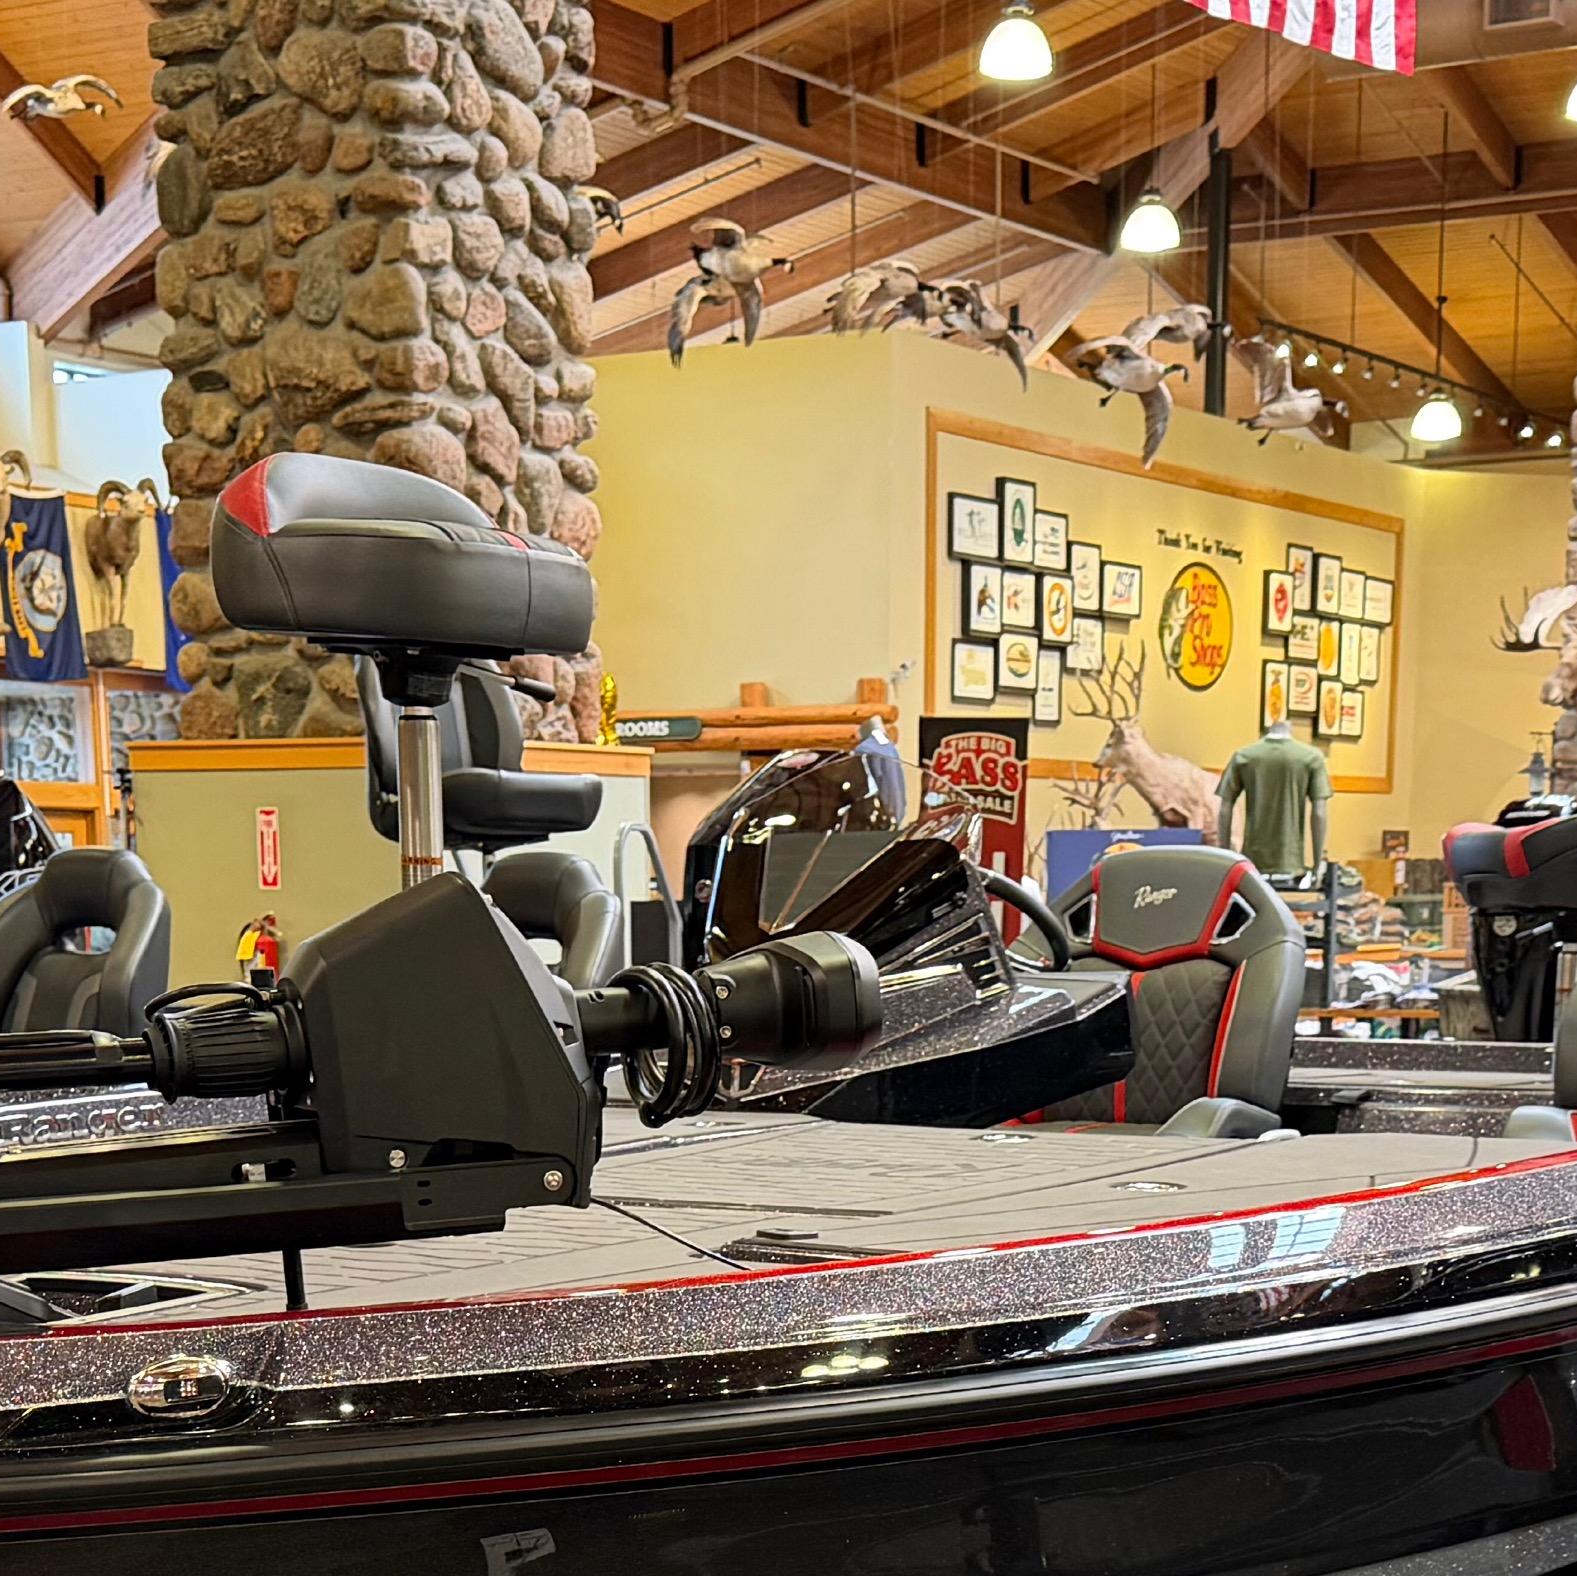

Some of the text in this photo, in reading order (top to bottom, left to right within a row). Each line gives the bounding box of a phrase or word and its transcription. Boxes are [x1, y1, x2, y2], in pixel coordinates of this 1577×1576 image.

[1189, 573, 1218, 608] Bass
[1189, 611, 1212, 638] Pro
[1190, 635, 1224, 675] Shops
[950, 736, 1007, 753] THE BIG
[1134, 885, 1178, 910] Ranger
